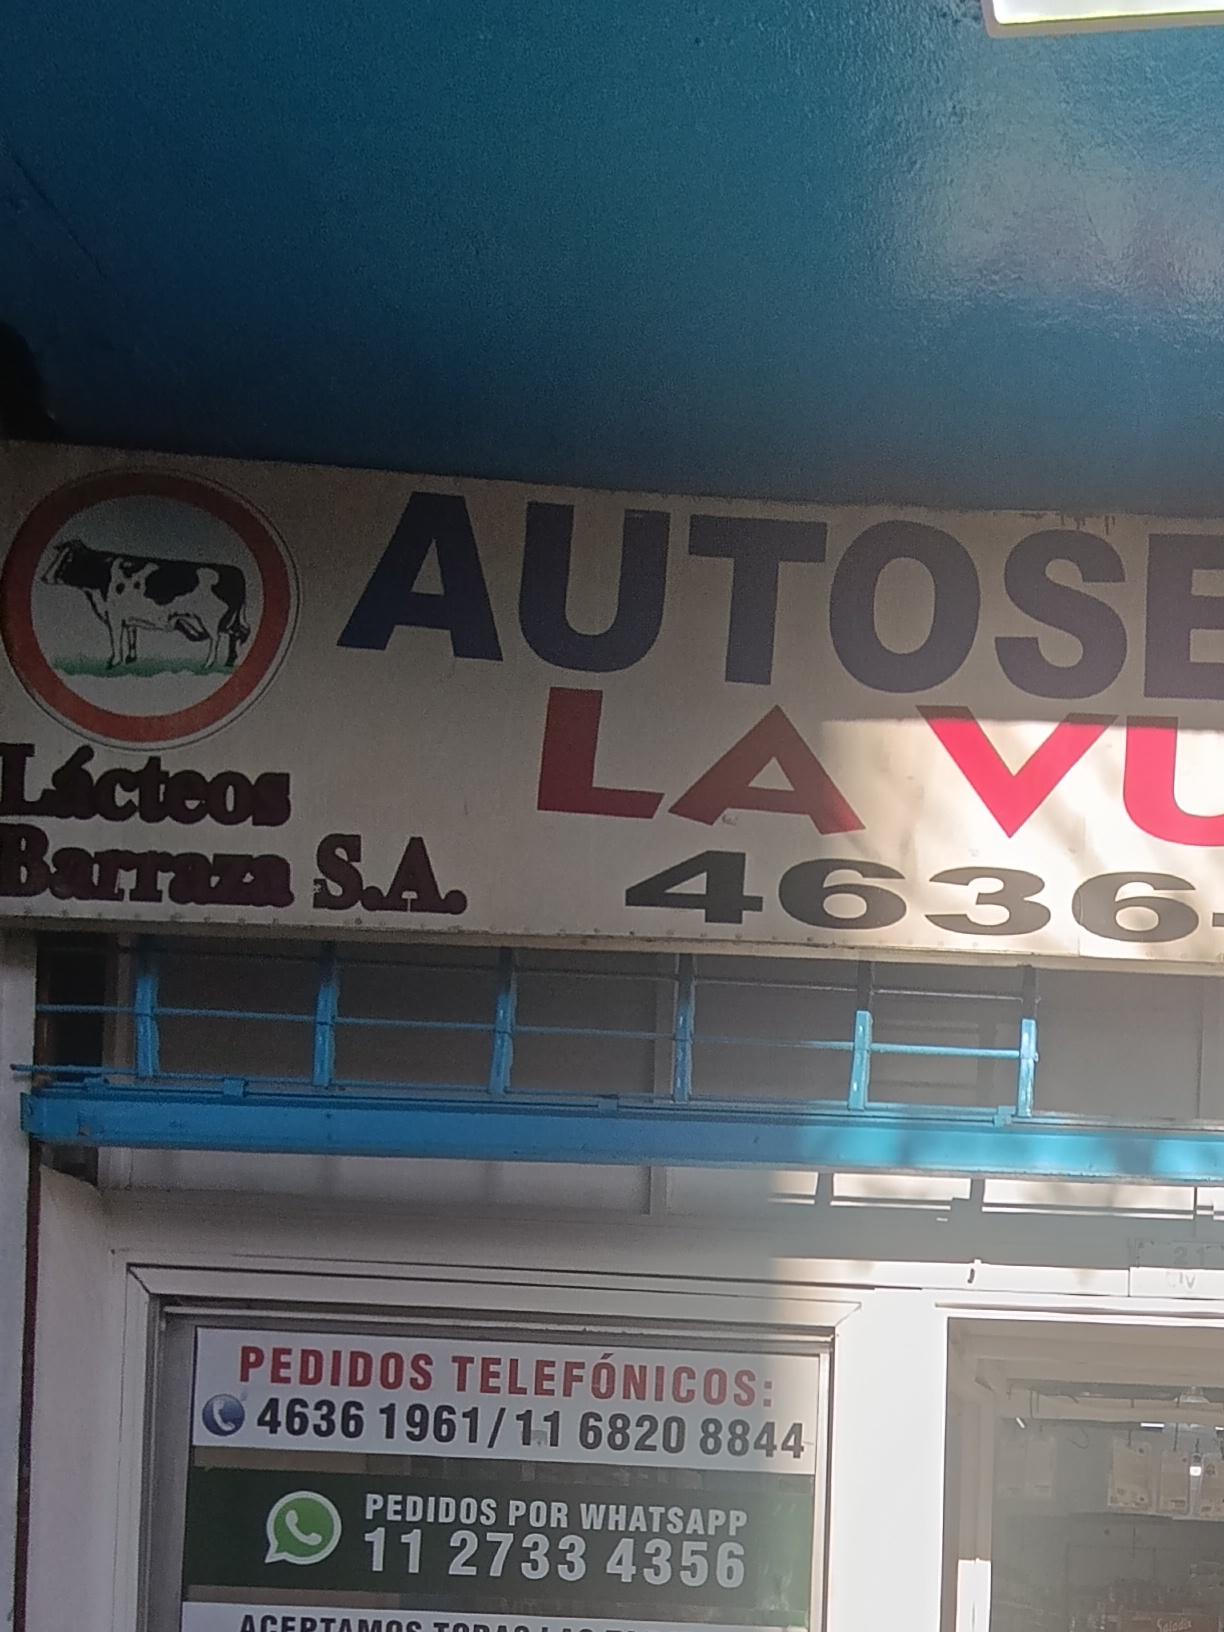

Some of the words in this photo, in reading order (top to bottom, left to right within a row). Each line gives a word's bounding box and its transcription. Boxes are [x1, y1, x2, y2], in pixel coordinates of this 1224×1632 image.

[537, 686, 866, 835] LA
[0, 824, 294, 908] Barraza
[314, 835, 467, 914] S.A.
[239, 1346, 433, 1392] PEDIDOS
[452, 1352, 773, 1407] TELEFÓNICOS:
[257, 1397, 364, 1439] 4636
[578, 1416, 685, 1454] 6820
[699, 1418, 804, 1460] 8844
[365, 1493, 497, 1526] PEDIDOS
[508, 1500, 569, 1529] POR
[580, 1503, 747, 1536] WHATSAPP
[364, 1527, 421, 1573] 11
[448, 1530, 586, 1580] 2733
[605, 1538, 744, 1588] 4356
